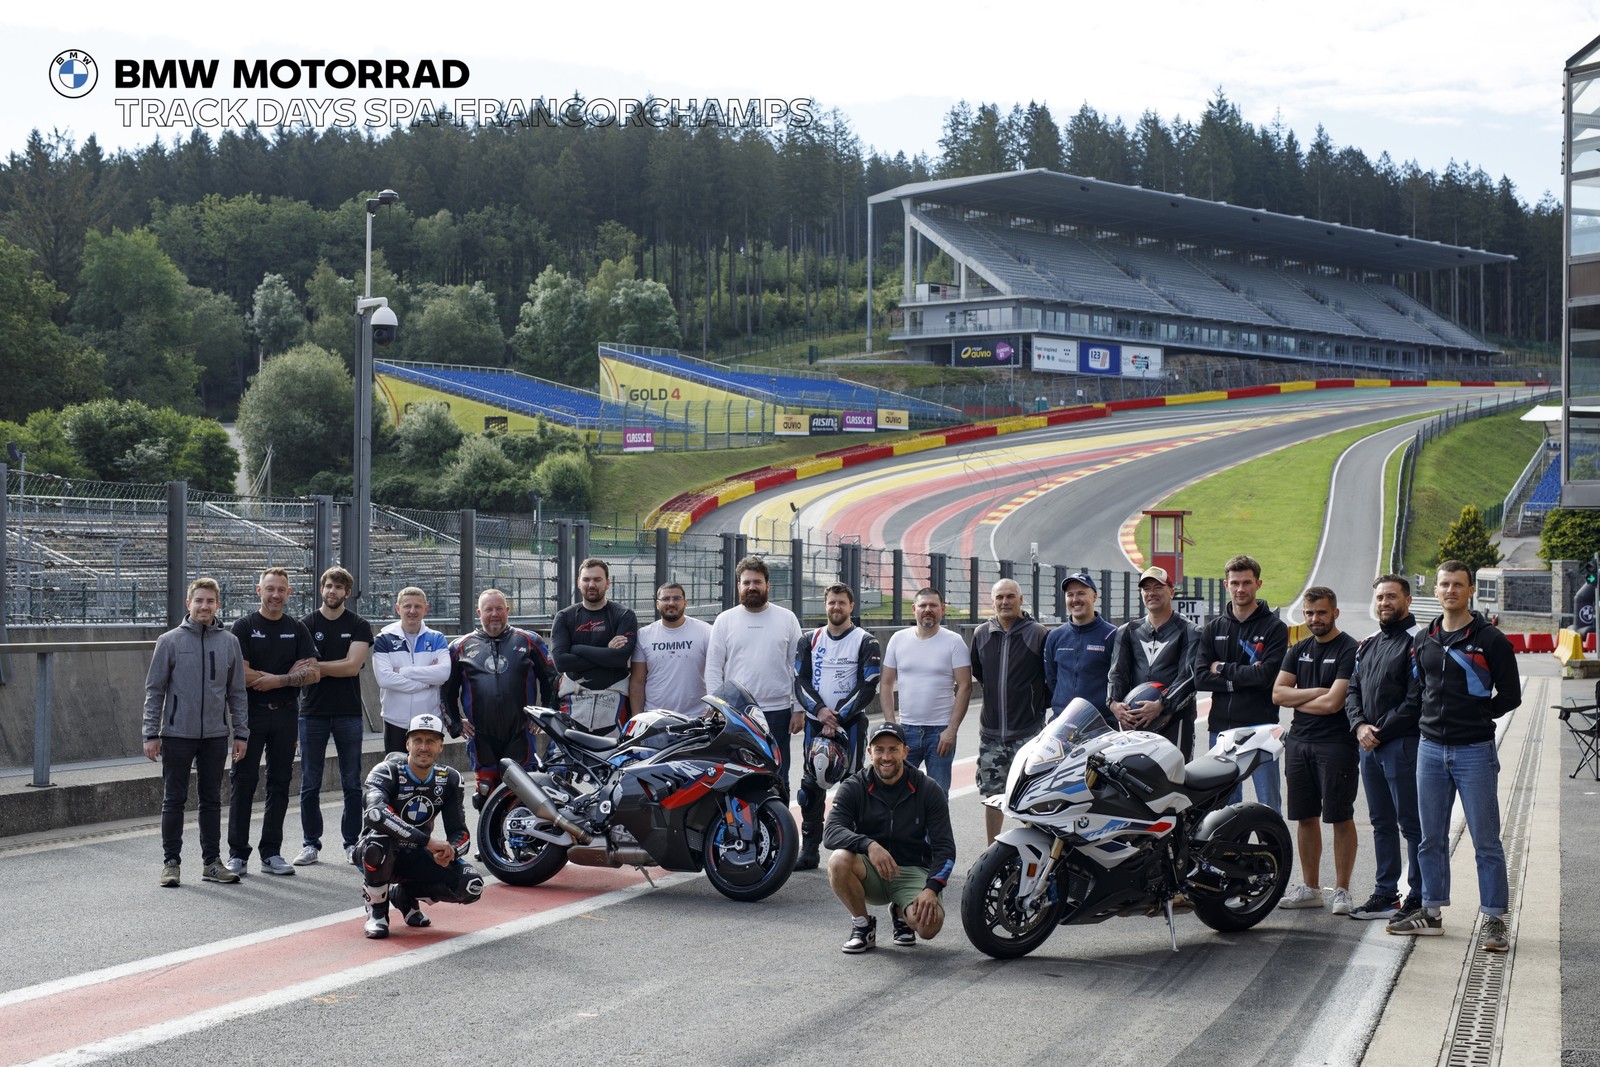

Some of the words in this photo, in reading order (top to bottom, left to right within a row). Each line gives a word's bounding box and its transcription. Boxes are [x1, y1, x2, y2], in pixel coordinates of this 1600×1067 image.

[1090, 350, 1101, 359] 123
[629, 388, 668, 401] GOLD
[671, 387, 681, 400] 4
[845, 415, 865, 425] CLASSIC
[626, 433, 645, 443] CLASSIC
[1177, 601, 1197, 614] PIT
[651, 640, 693, 652] TOMMY
